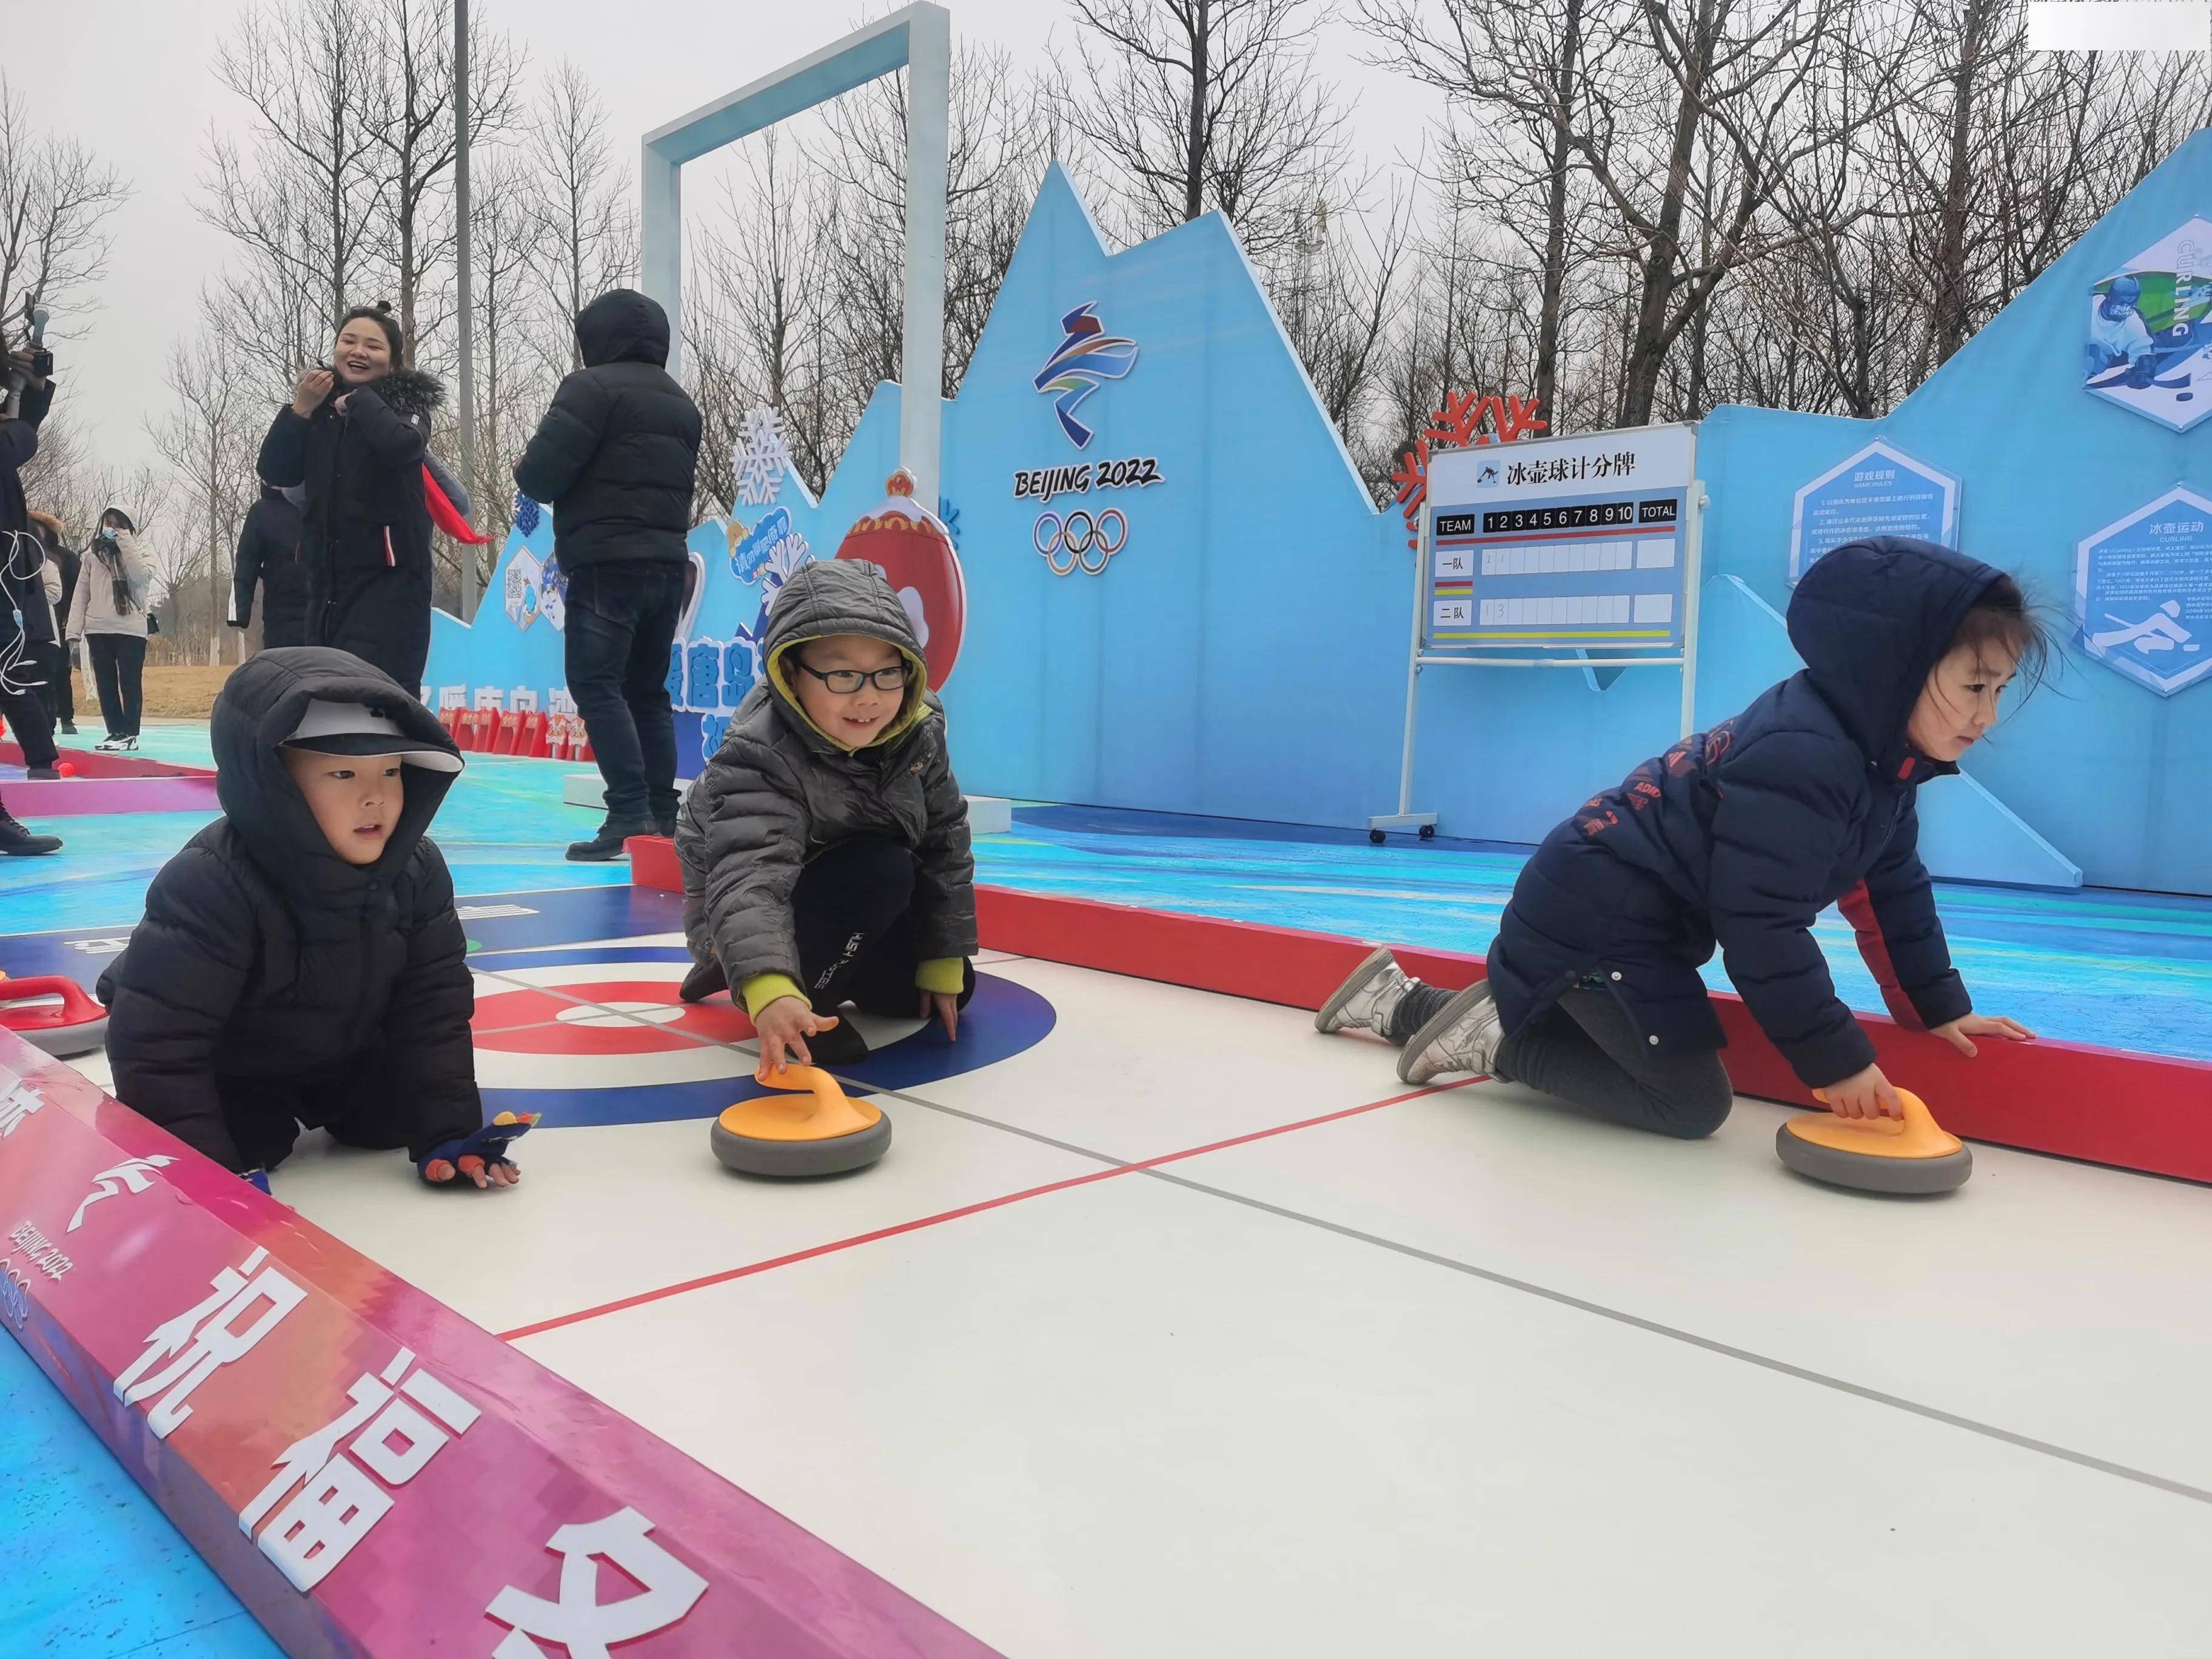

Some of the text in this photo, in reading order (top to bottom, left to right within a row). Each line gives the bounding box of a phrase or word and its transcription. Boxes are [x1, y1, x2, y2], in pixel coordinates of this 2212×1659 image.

[2173, 240, 2195, 337] CURLING
[1015, 457, 1163, 502] BEIJING 2022
[1506, 451, 1637, 486] 冰壶球计分牌
[1439, 505, 1675, 532] TEAM 1 2 3 4 5 6 7 8 9 10 TOTAL
[2149, 521, 2204, 535] 冰壶运动
[1442, 557, 1464, 571] 一队
[1440, 606, 1464, 620] 二队
